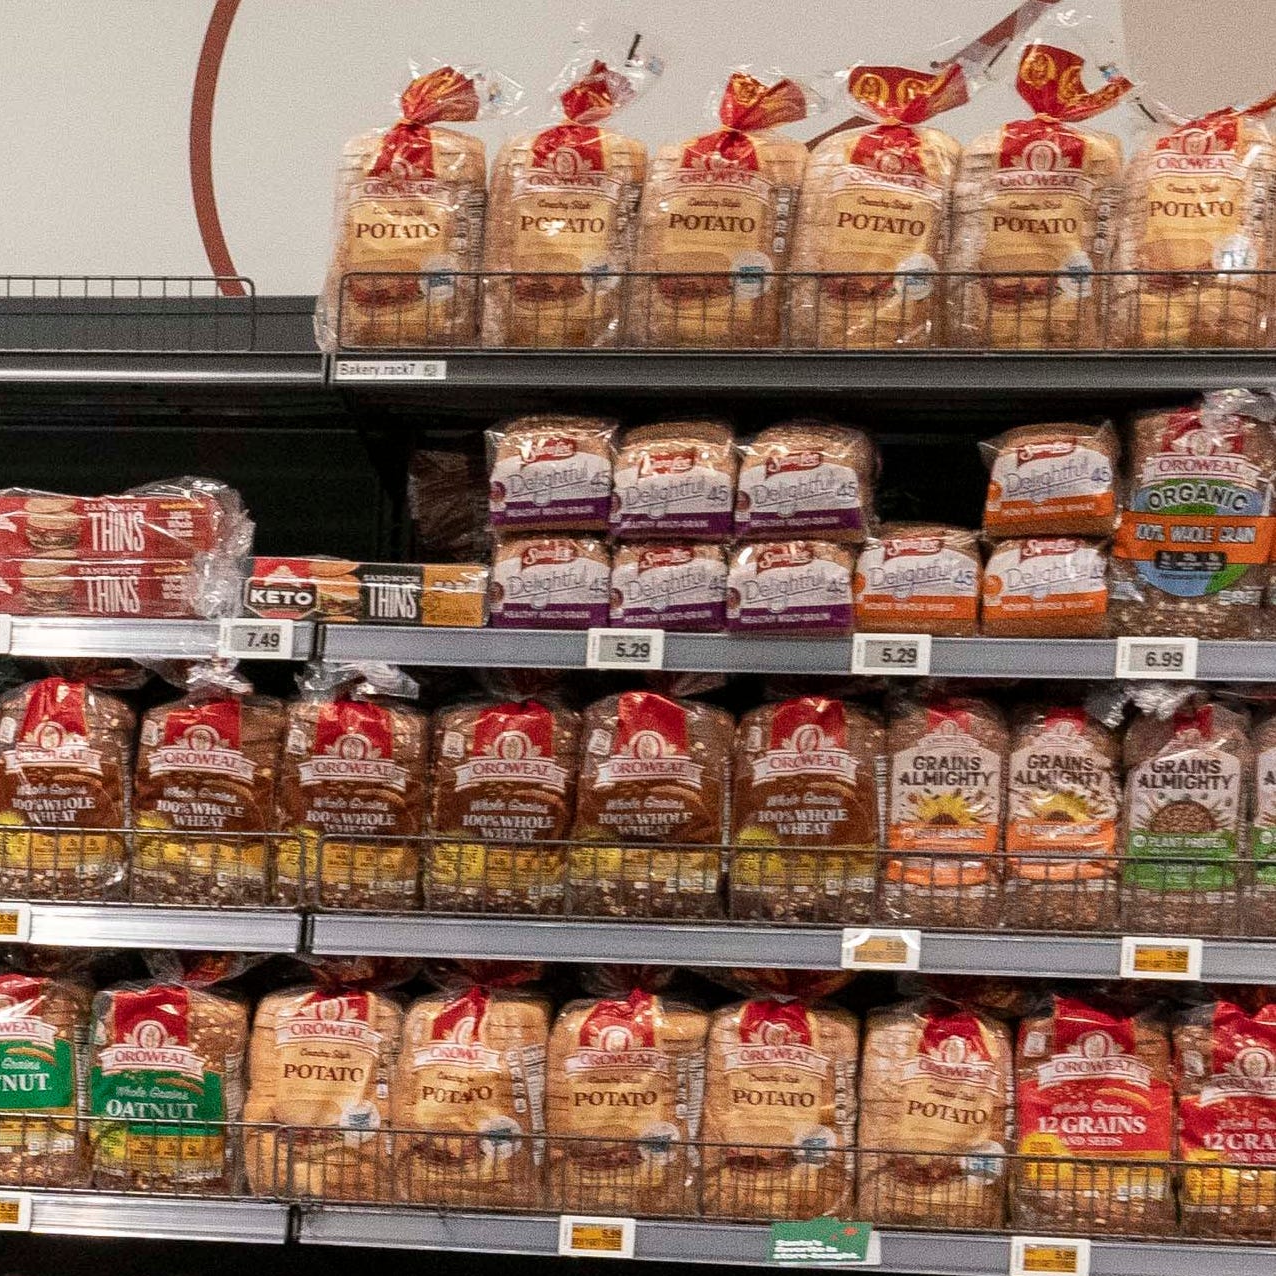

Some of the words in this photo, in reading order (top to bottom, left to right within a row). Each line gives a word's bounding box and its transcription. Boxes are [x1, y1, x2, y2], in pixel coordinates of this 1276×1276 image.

[1149, 484, 1248, 513] ORGANIC
[87, 512, 145, 552] THINS
[86, 575, 141, 613] THINS
[249, 589, 313, 606] KETO
[369, 584, 417, 618] THINS
[247, 631, 280, 648] 7.49
[616, 642, 650, 658] 5.29
[882, 647, 917, 664] 5.29
[1146, 651, 1183, 667] 6.99
[912, 755, 982, 773] GRAINS
[1026, 753, 1094, 773] GRAINS
[1151, 758, 1221, 776] GRAINS
[900, 770, 993, 789] ALMIGHTY
[1014, 768, 1111, 787] ALMIGHTY
[1138, 773, 1235, 793] ALMIGHTY
[283, 1064, 364, 1082] POTATO
[574, 1090, 657, 1107] POTATO
[732, 1089, 815, 1107] POTATO
[105, 1098, 198, 1120] OATNUT
[907, 1099, 987, 1124] POTATO
[1062, 1116, 1146, 1134] GRAINS
